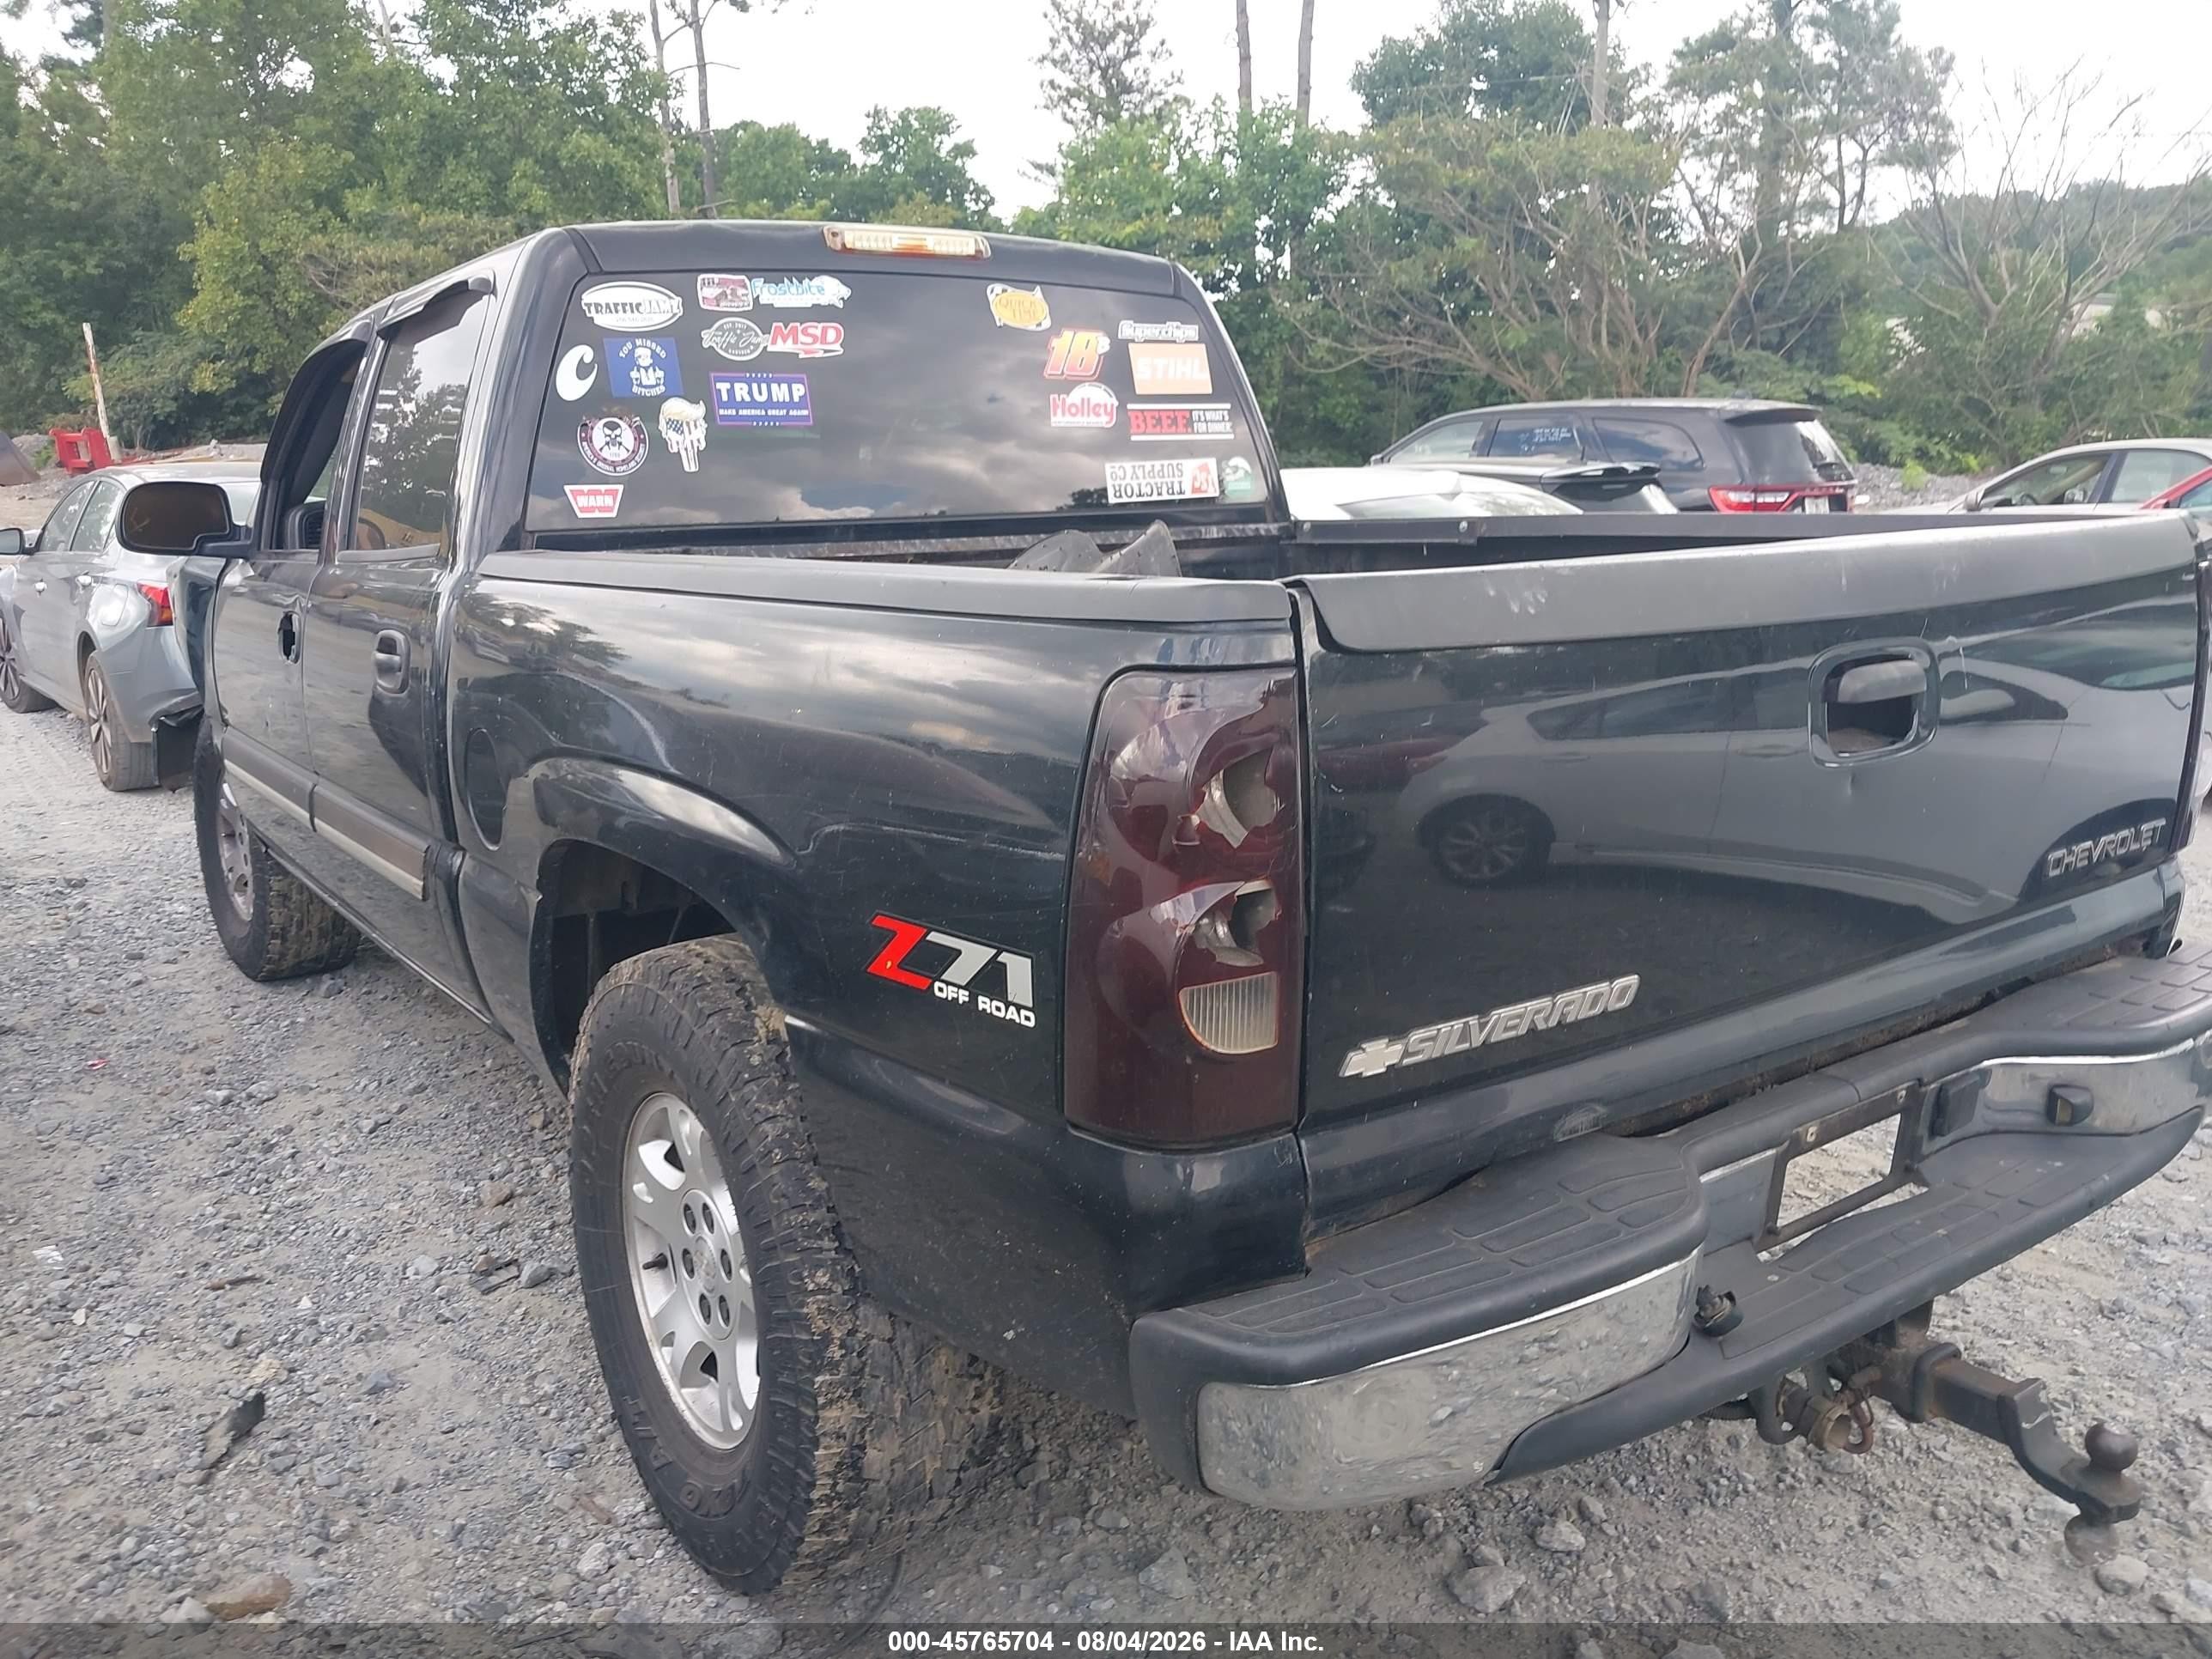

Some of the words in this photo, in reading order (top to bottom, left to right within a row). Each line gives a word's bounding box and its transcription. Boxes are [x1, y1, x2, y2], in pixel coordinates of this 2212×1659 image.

[769, 324, 843, 346] MSD
[1045, 330, 1099, 376] 18
[1135, 356, 1209, 380] STIHL
[714, 381, 805, 403] TRUMP
[1051, 396, 1115, 425] Holley
[1130, 462, 1183, 483] SUPPLY
[1113, 480, 1186, 499] TRACTOR
[2047, 817, 2166, 878] CHEVROLET
[866, 914, 1034, 1008] Z71
[933, 981, 969, 1005] OFF
[977, 994, 1036, 1028] ROAD
[1395, 973, 1641, 1069] SILVERADO
